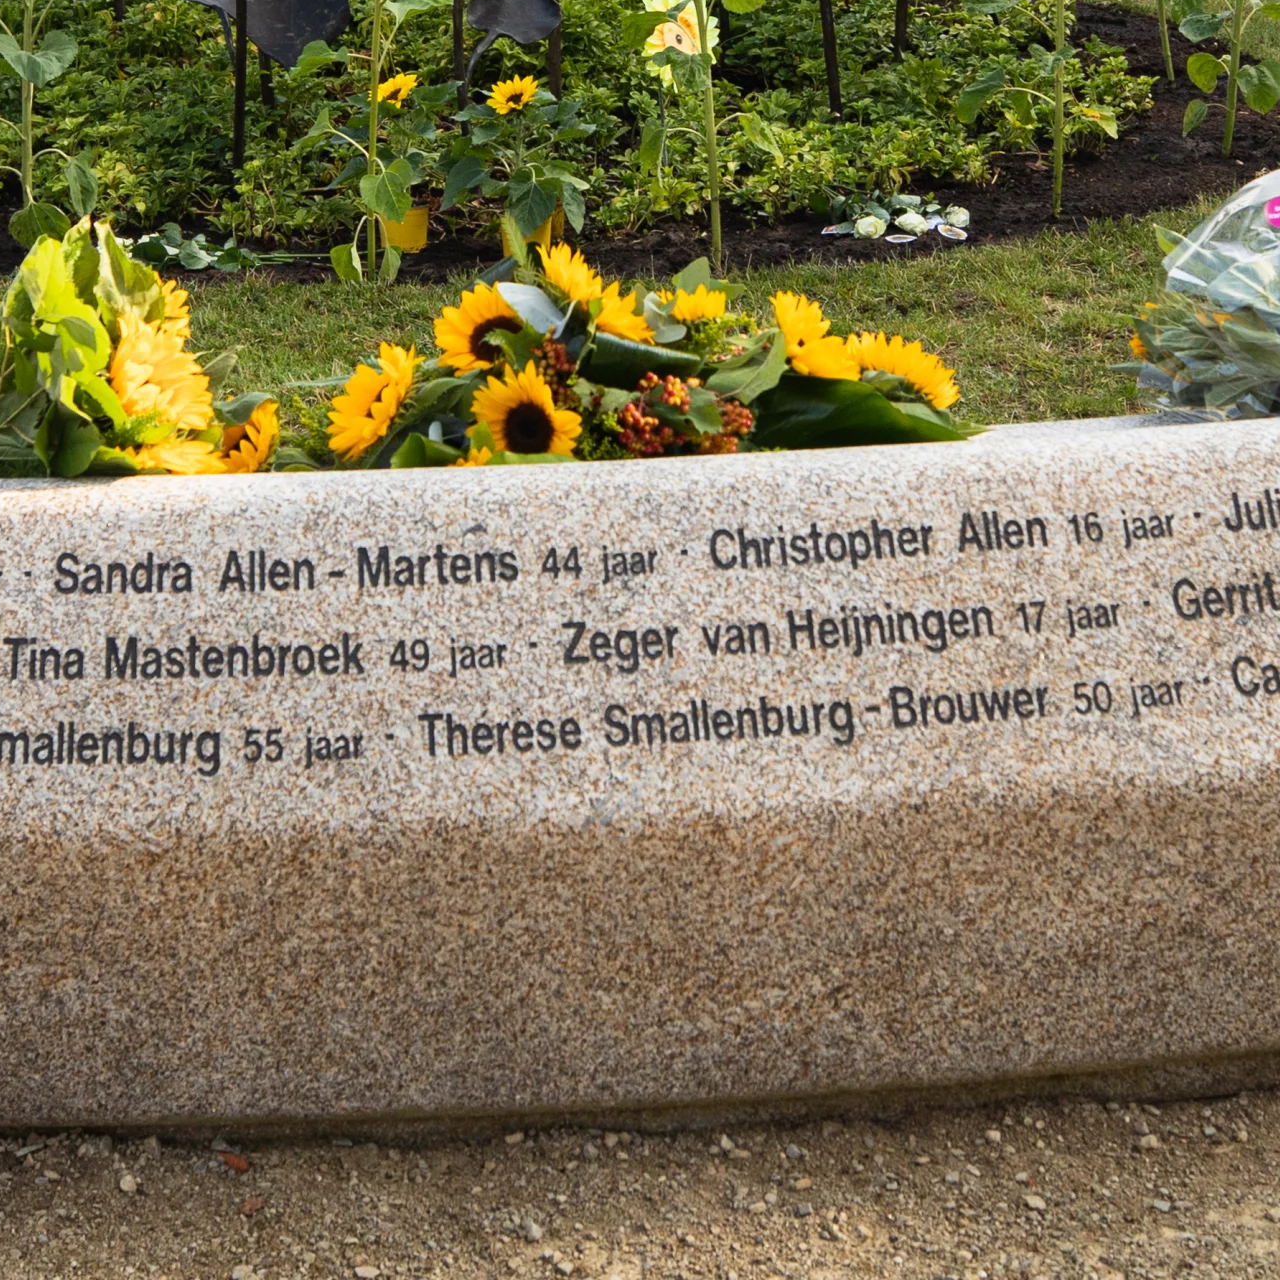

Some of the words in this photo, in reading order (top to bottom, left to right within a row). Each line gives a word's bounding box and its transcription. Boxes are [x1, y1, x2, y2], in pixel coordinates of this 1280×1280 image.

[54, 551, 194, 595] Sandra
[540, 548, 583, 579] 44
[601, 547, 659, 585] jaar
[710, 517, 934, 572] Christopher
[957, 510, 1049, 553] Allen
[1068, 511, 1105, 545] 16
[1123, 510, 1177, 550] jaar
[3, 635, 85, 682] Tina
[105, 632, 366, 681] Mastenbroek
[388, 640, 432, 673] 49
[448, 638, 509, 677] jaar
[562, 620, 679, 674] Zeger
[702, 622, 772, 658] van
[788, 601, 995, 659] Heijningen
[1016, 600, 1048, 635] 17
[1065, 599, 1124, 640] jaar
[243, 729, 284, 763] 55
[303, 729, 364, 770] jaar
[1073, 680, 1114, 716] 50
[1129, 677, 1186, 718] jaar
